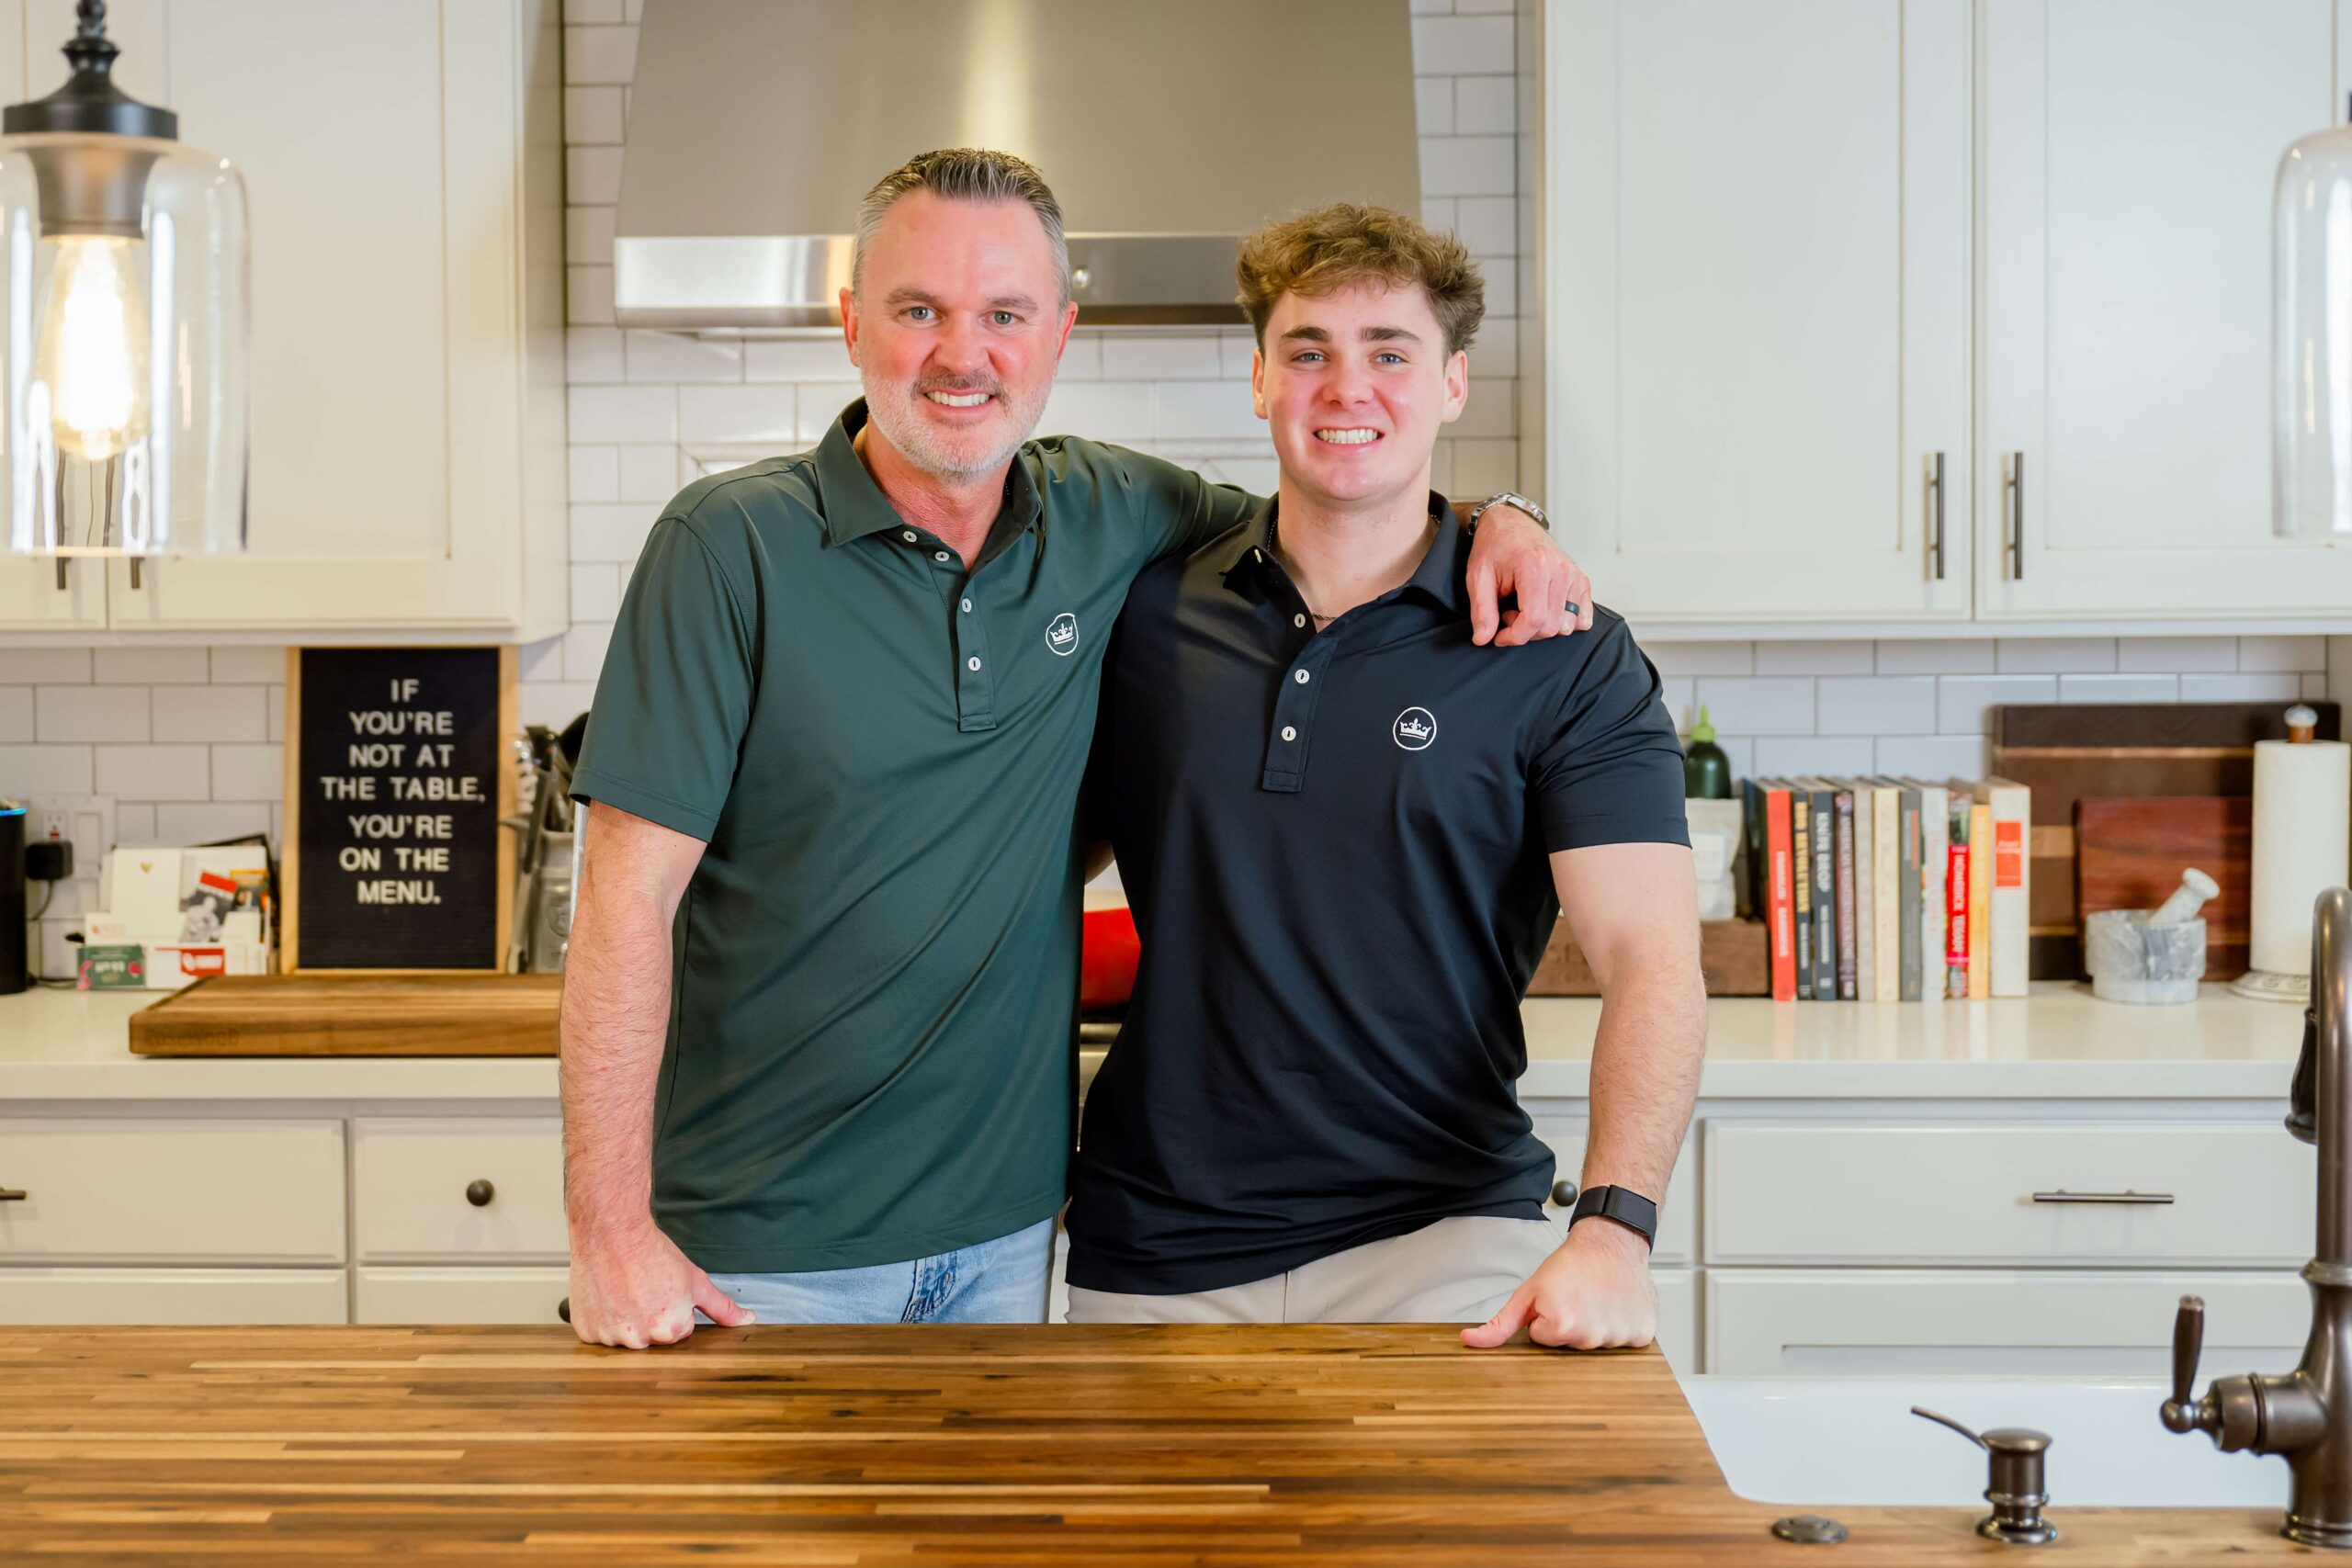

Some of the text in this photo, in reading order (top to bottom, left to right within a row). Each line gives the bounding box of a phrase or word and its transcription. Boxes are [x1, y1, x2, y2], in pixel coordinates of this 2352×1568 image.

[390, 679, 420, 703] IF
[349, 711, 454, 735] YOU'RE
[349, 744, 455, 768] NOT AT
[320, 777, 486, 803] THE TABLE,
[349, 815, 454, 840] YOU'RE
[339, 847, 450, 872] ON THE
[1816, 852, 1831, 893] DROP
[357, 880, 442, 905] MENU.
